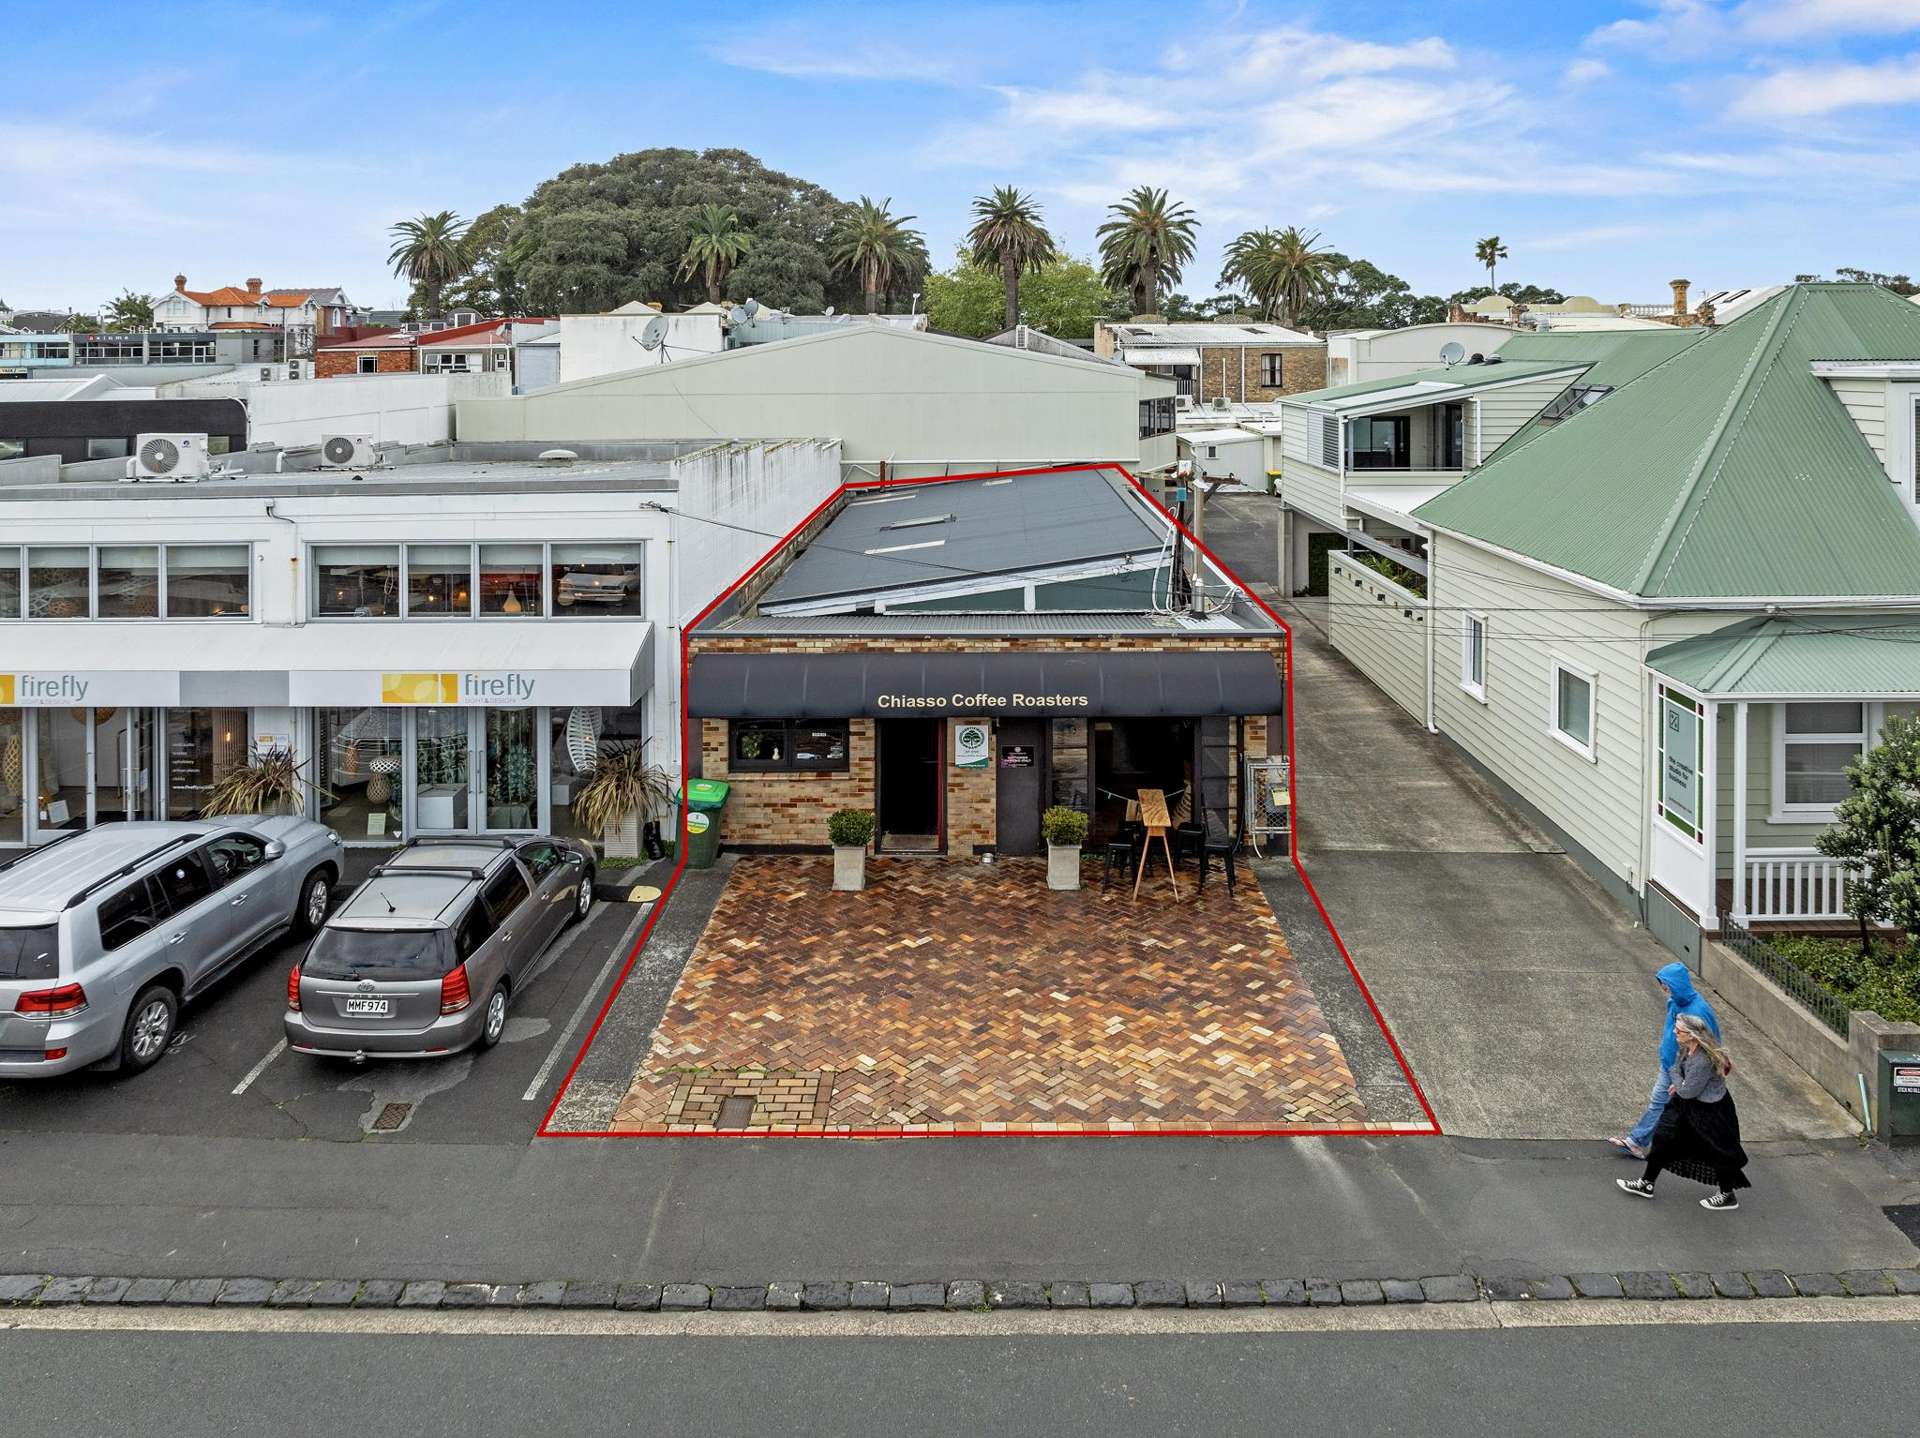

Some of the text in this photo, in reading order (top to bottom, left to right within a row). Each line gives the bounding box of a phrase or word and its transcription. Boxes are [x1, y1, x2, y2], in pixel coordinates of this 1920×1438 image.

[22, 675, 88, 702] firefly
[465, 674, 535, 700] firefly
[878, 693, 1088, 708] Chiasso Coffee Roasters
[348, 1001, 386, 1011] MMF974
